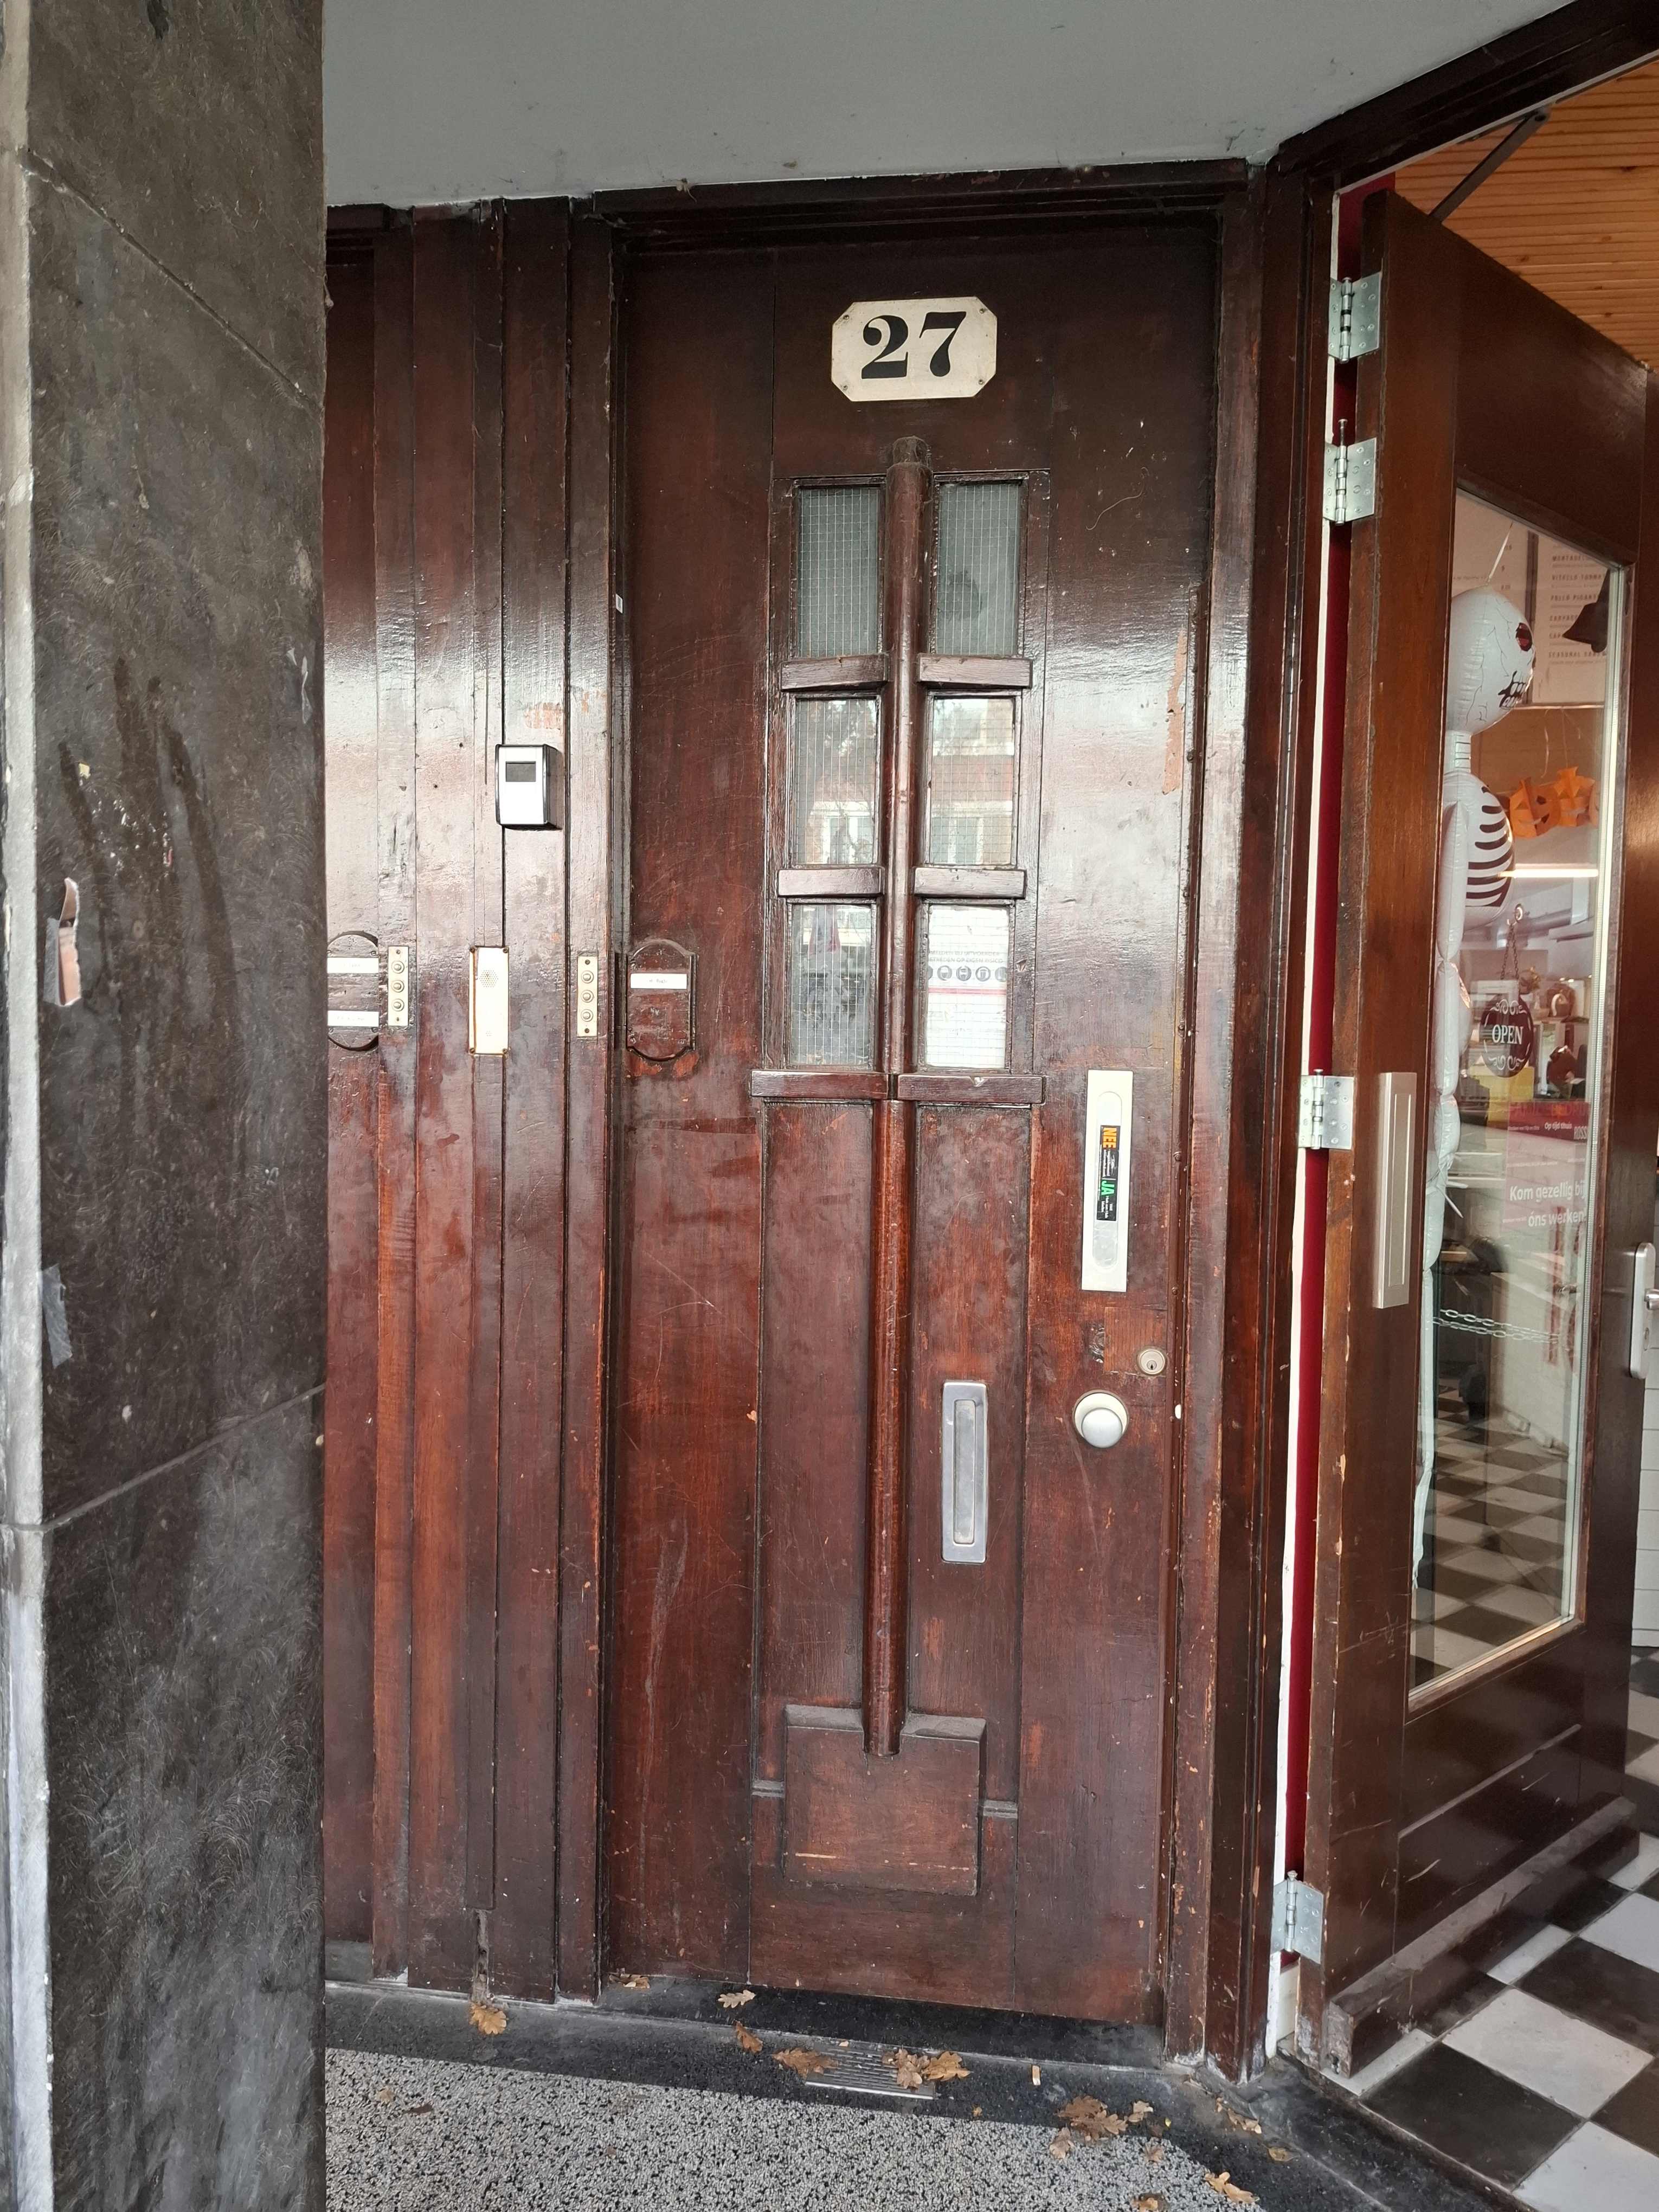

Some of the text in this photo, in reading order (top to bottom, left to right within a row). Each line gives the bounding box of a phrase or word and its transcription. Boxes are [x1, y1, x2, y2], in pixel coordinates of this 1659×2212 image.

[861, 311, 966, 379] 27
[1492, 1024, 1524, 1045] OPEN
[1545, 1122, 1551, 1130] Op
[1102, 1127, 1117, 1148] NEE
[1101, 1180, 1115, 1195] JA
[1510, 1186, 1534, 1201] Kom
[1535, 1181, 1572, 1203] gezellig
[1528, 1210, 1546, 1227] óns
